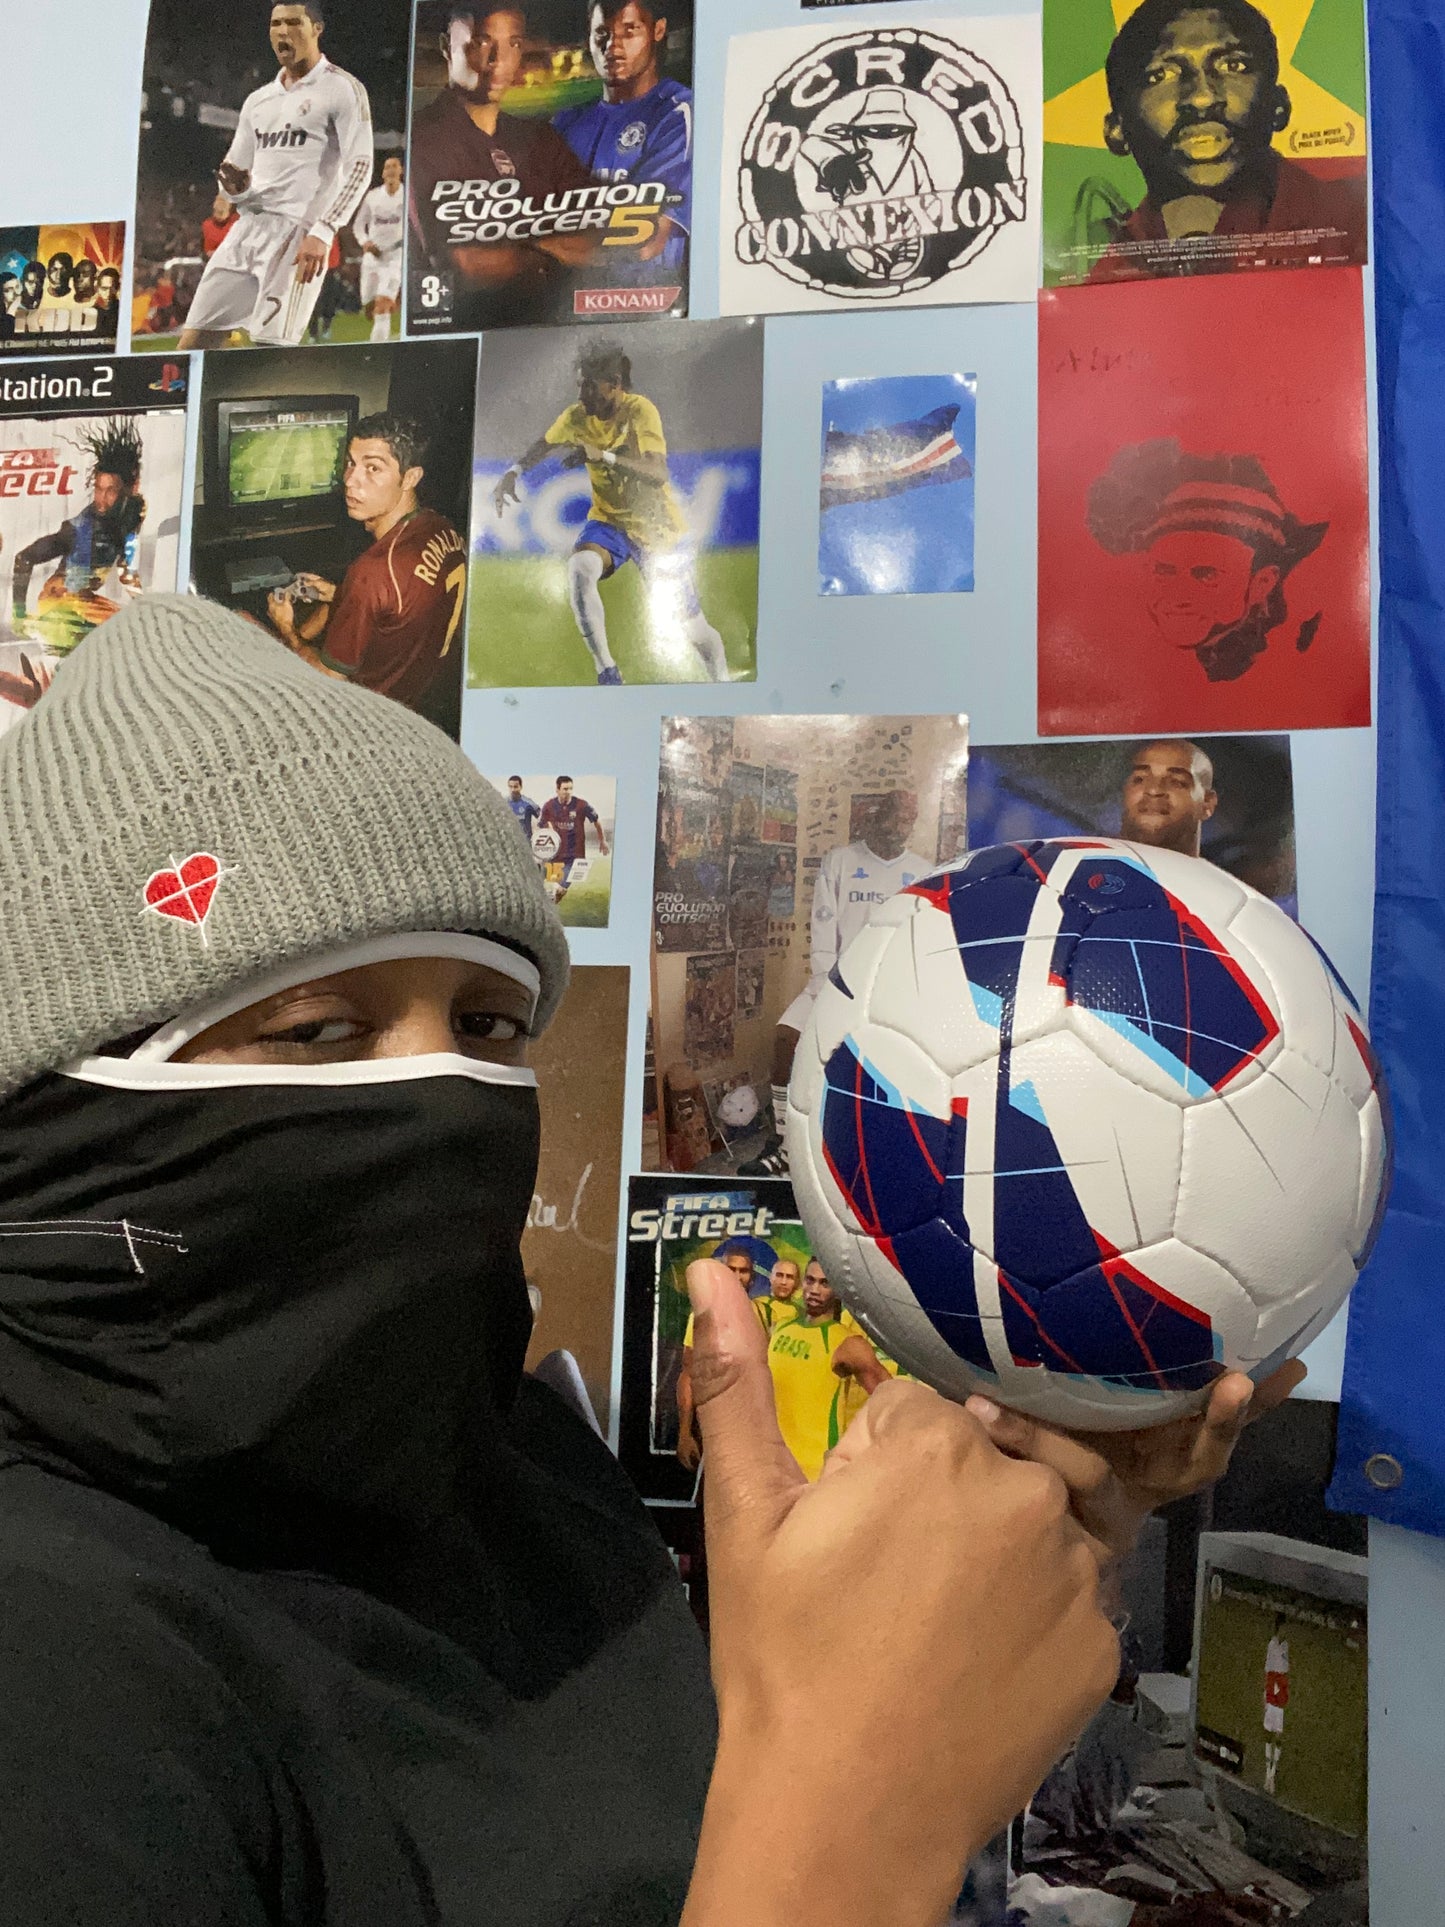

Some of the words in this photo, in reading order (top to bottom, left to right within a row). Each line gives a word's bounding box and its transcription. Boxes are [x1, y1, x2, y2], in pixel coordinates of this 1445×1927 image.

[757, 46, 1004, 171] SCRED
[431, 178, 521, 201] PRO
[435, 182, 667, 221] EVOLUTION
[447, 208, 611, 244] SOCCER
[602, 205, 661, 246] 5
[584, 292, 665, 309] KONAMI
[439, 562, 466, 658] 7
[535, 834, 556, 847] EA
[654, 891, 685, 903] PRO
[665, 1196, 731, 1212] FIFA
[629, 1206, 774, 1242] Street
